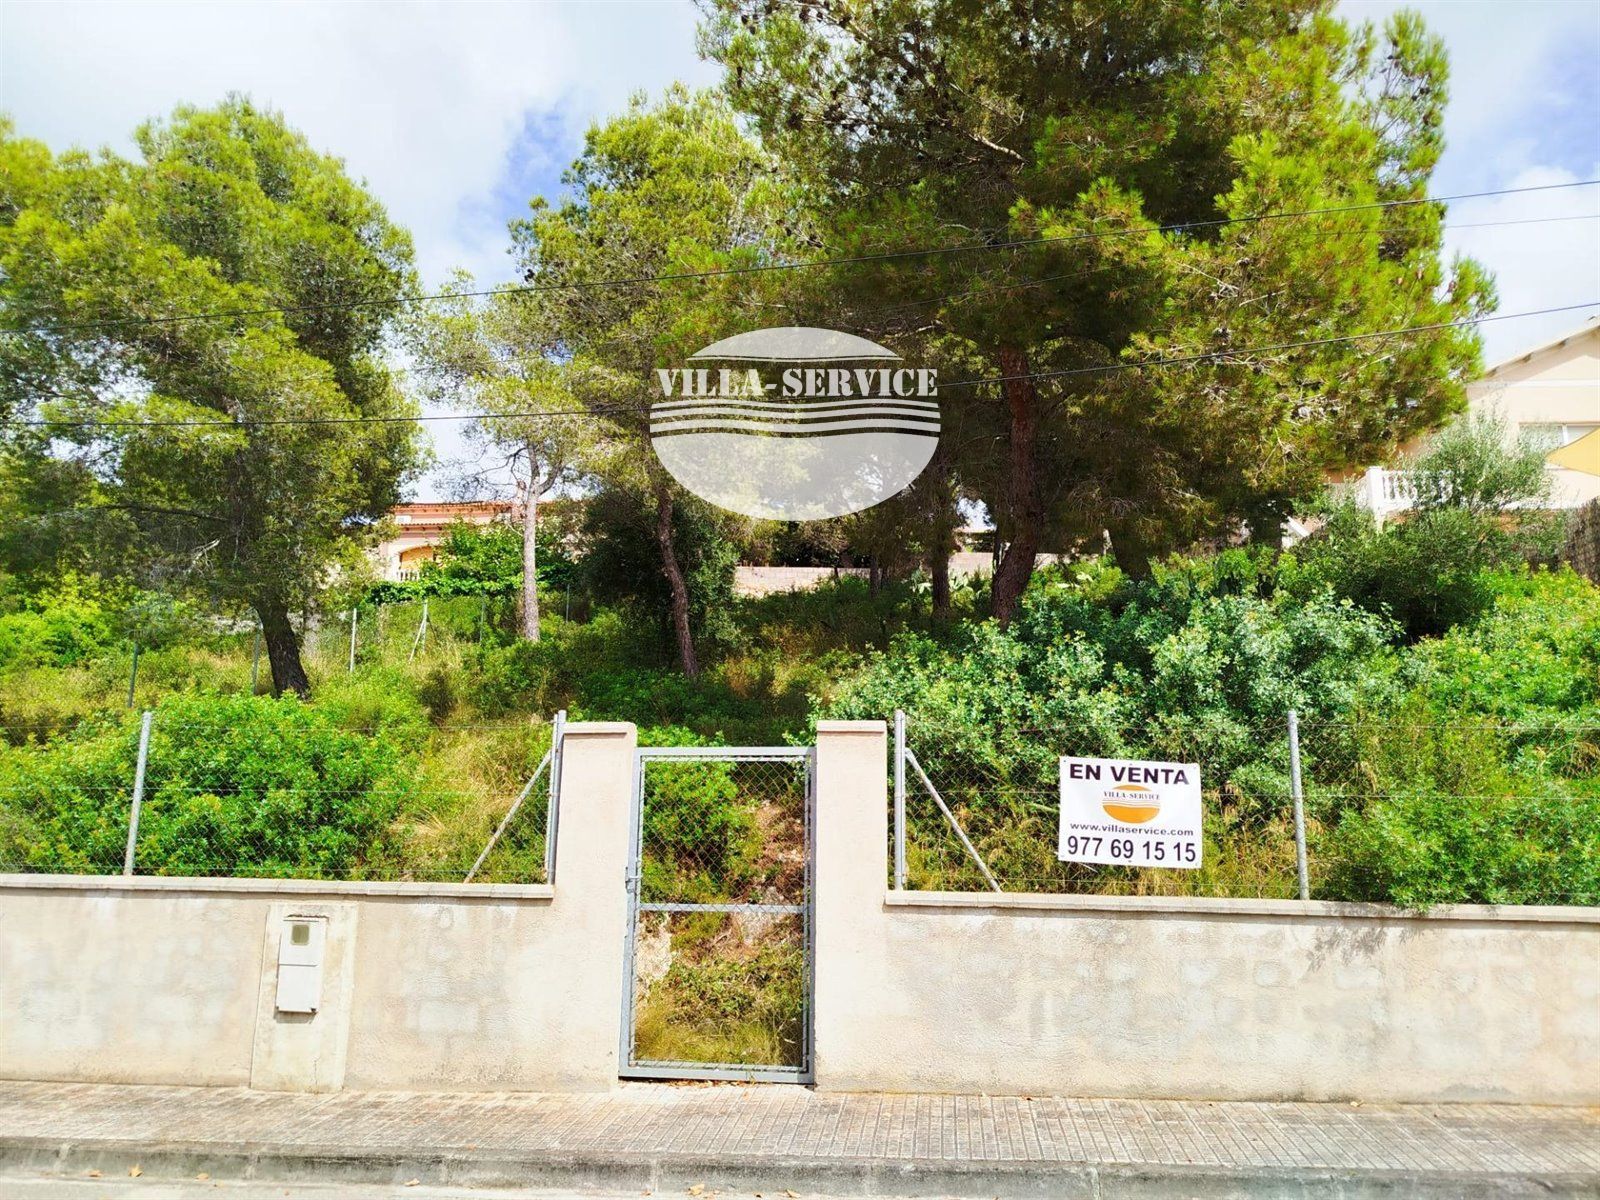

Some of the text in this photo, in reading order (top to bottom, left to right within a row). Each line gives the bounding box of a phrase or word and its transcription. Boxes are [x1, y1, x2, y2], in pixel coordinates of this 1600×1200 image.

[1070, 763, 1189, 785] EN VENTA
[1070, 823, 1194, 836] www.villaservice.com
[1067, 835, 1196, 862] 977 69 15 15
